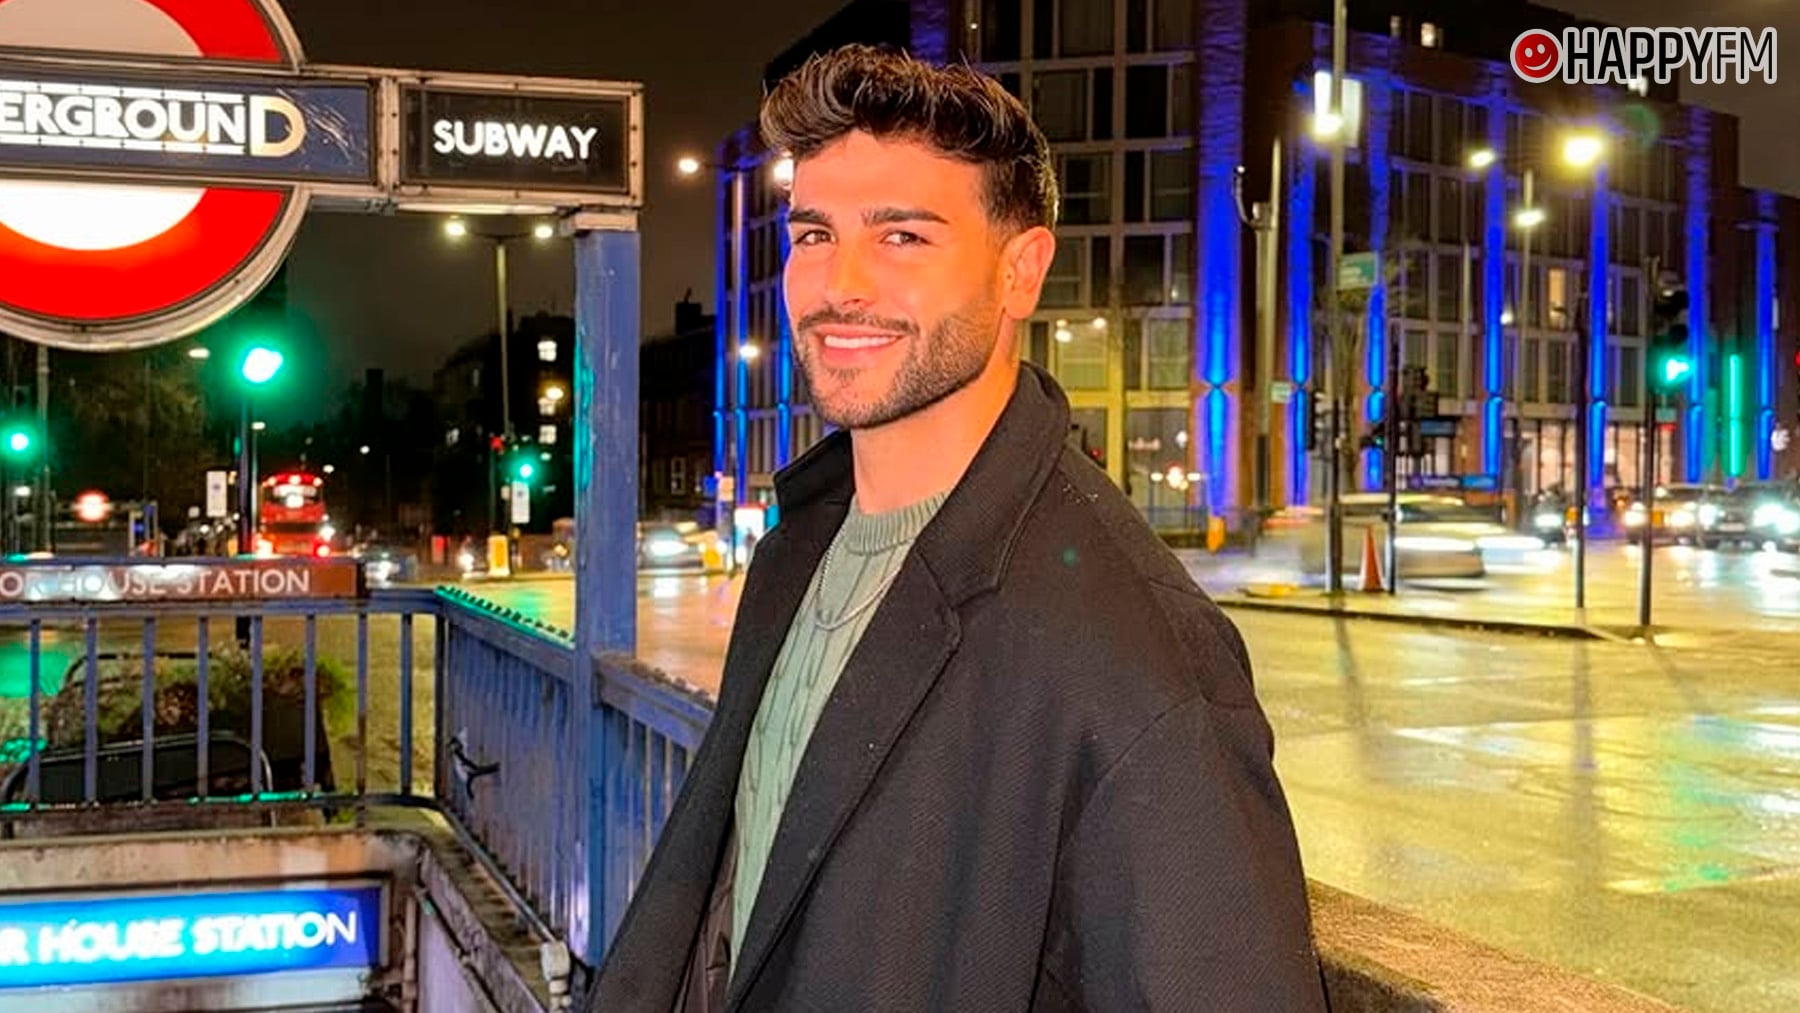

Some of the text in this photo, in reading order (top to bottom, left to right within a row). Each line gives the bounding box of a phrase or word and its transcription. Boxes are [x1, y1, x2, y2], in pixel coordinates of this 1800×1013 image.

[0, 91, 306, 157] ERGROUND
[433, 119, 598, 159] SUBWAY
[176, 569, 310, 594] STATION
[38, 918, 186, 964] HOUSE
[191, 910, 357, 955] STATION
